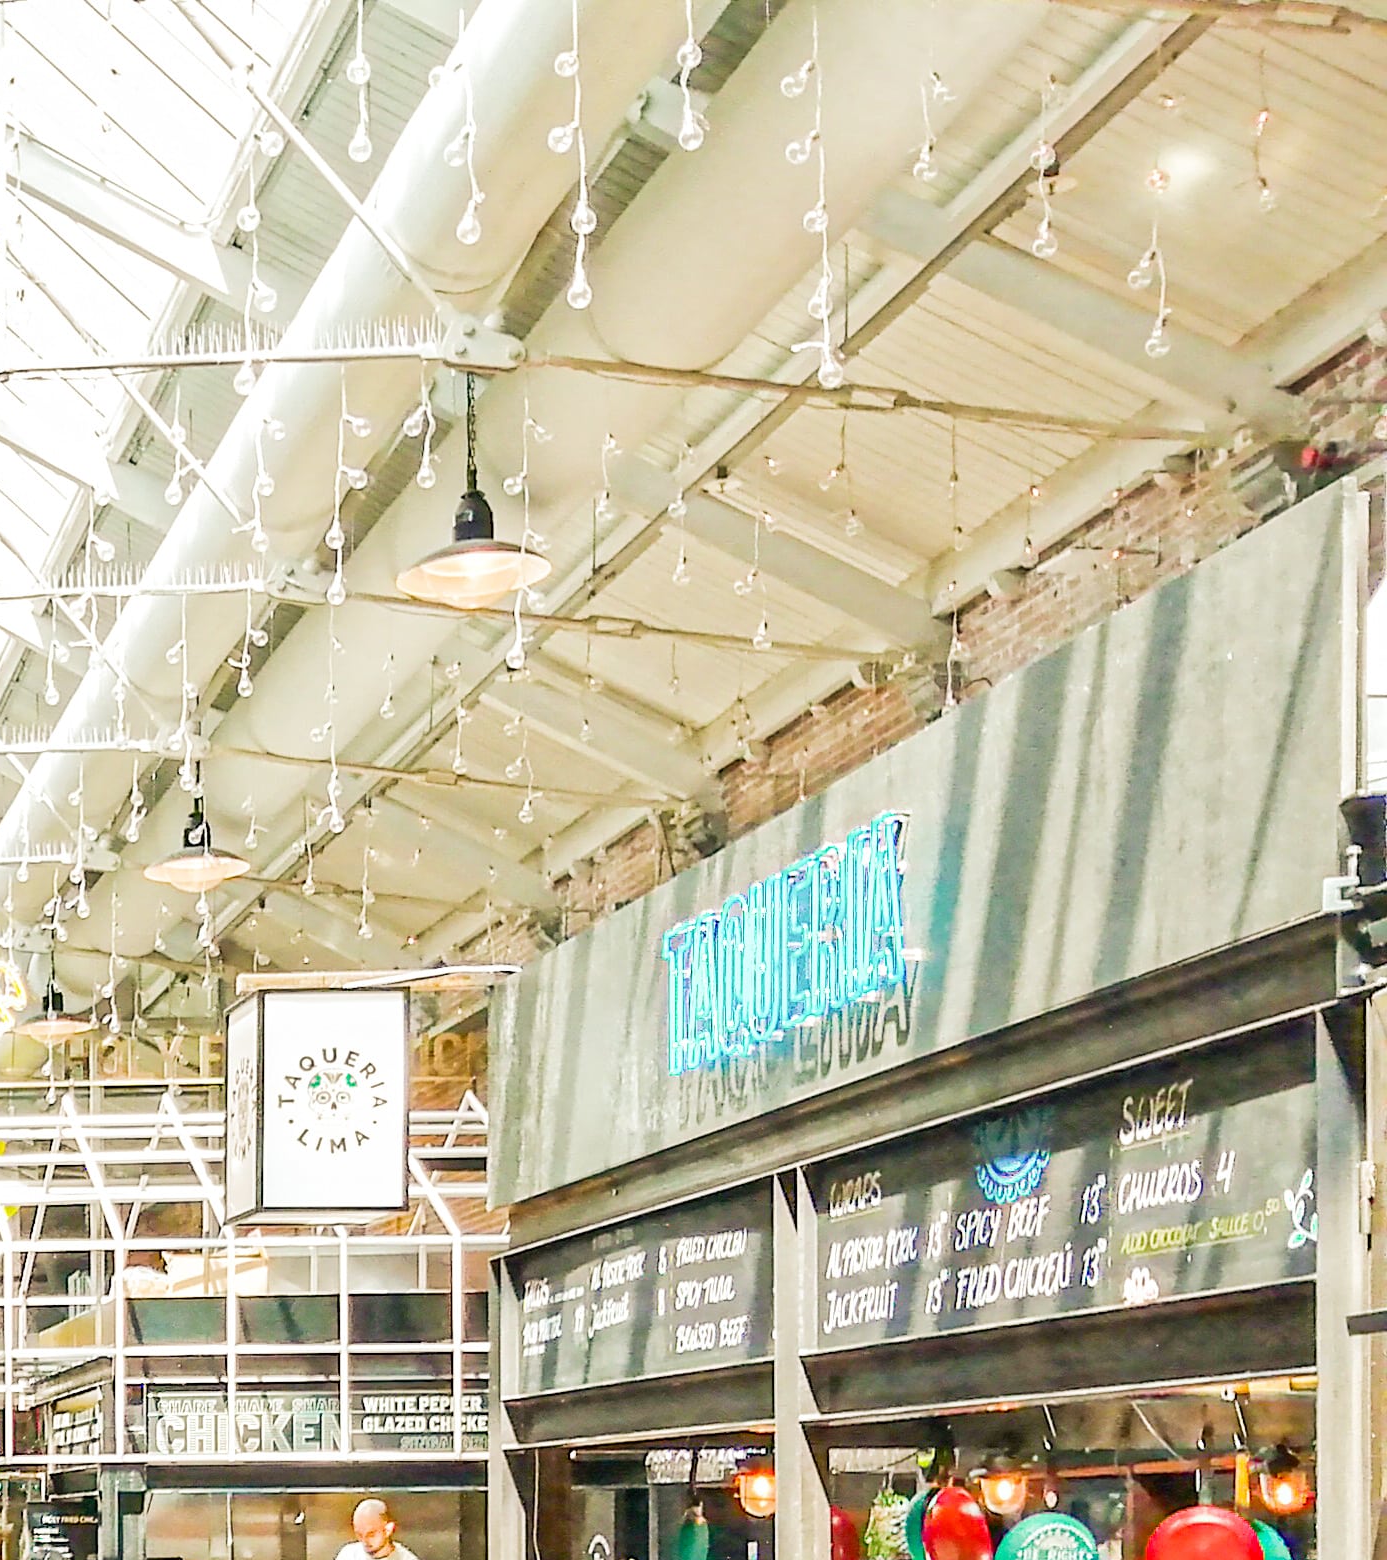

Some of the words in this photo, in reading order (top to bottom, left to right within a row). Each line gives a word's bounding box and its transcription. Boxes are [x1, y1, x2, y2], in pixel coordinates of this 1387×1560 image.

[662, 809, 911, 1076] TAQUERIA
[278, 1048, 387, 1109] TAQUERIA
[1118, 1078, 1193, 1146] SWEET
[297, 1129, 370, 1153] LIMA
[1117, 1160, 1203, 1214] CHURROS
[1216, 1150, 1236, 1194] 4
[955, 1209, 1002, 1251] SPICY
[1006, 1194, 1051, 1243] BEEF
[823, 1280, 899, 1334] JACKFRUIT
[955, 1263, 1002, 1309] FRIED
[235, 1398, 285, 1413] HARE
[292, 1397, 341, 1413] SHAR
[362, 1416, 427, 1433] GLAZED
[363, 1396, 417, 1413] WHITE
[1048, 1550, 1084, 1560] RIGHT
